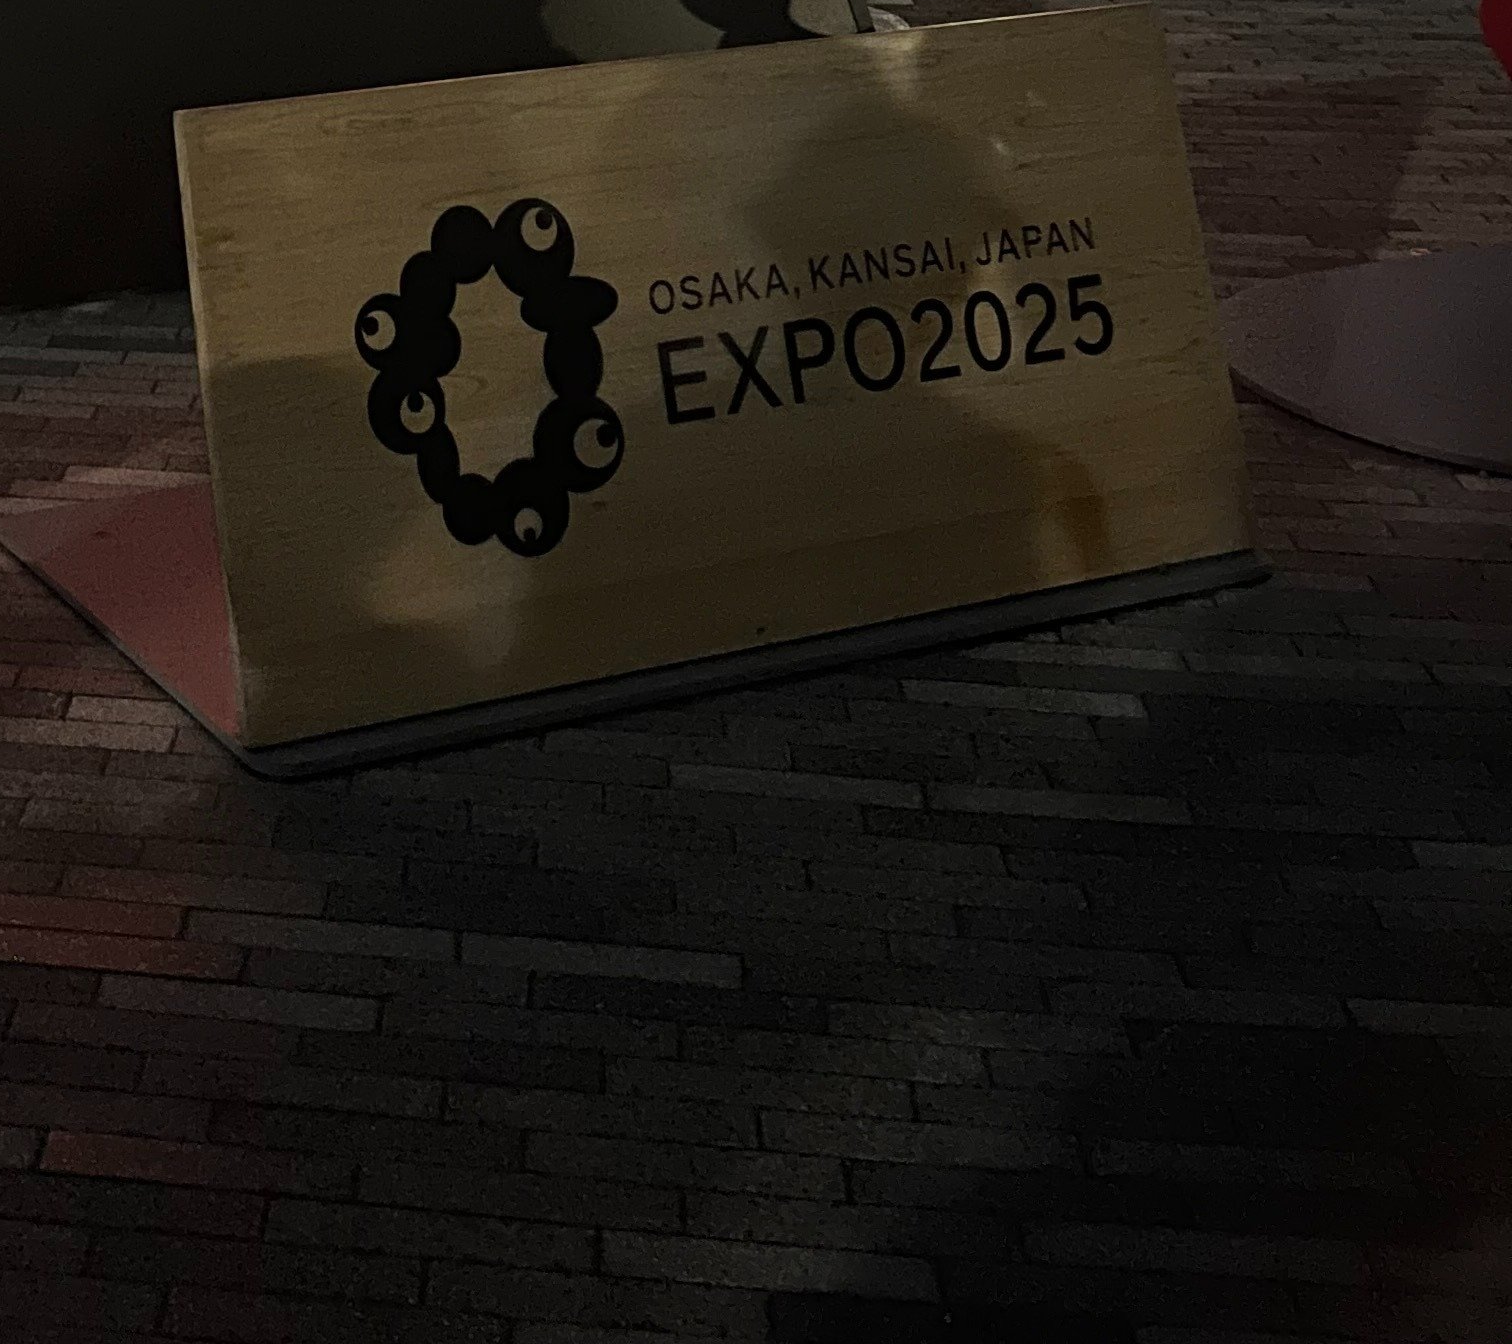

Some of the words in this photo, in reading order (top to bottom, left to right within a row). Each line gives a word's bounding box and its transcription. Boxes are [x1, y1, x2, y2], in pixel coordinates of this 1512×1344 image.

[649, 264, 801, 314] OSAKA,
[808, 237, 967, 290] KANSAI,
[975, 217, 1095, 266] JAPAN
[657, 274, 1114, 424] EXPO2025
